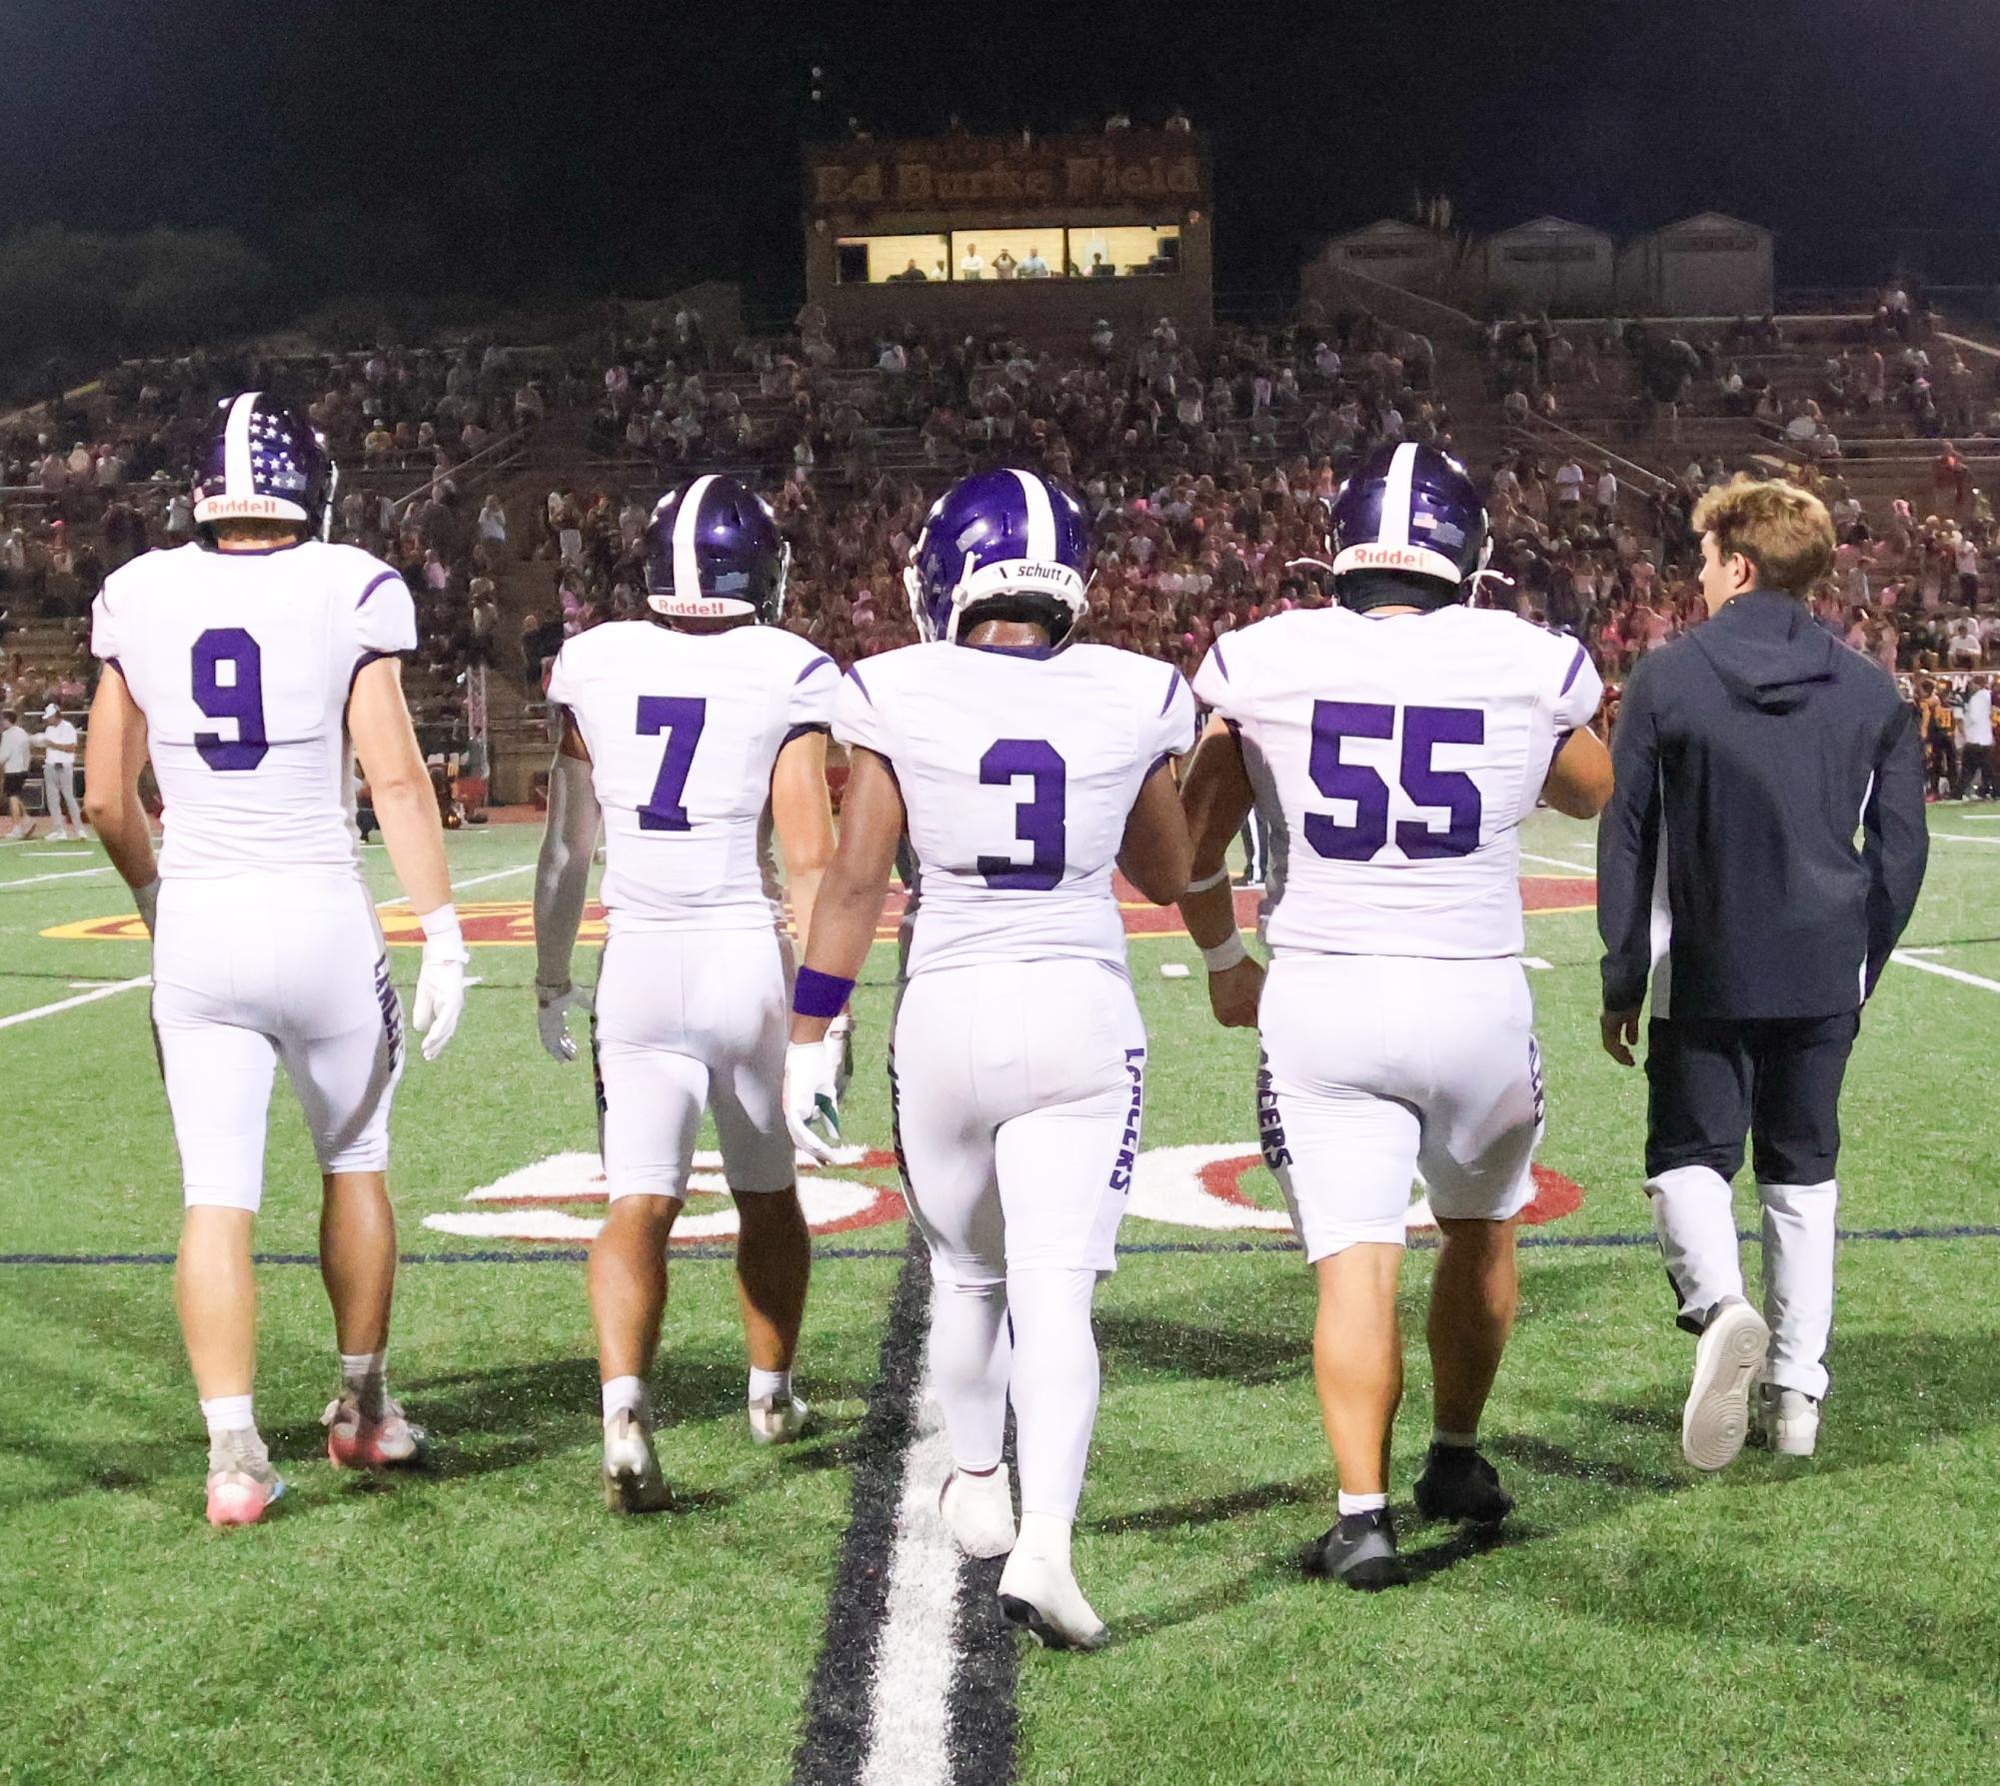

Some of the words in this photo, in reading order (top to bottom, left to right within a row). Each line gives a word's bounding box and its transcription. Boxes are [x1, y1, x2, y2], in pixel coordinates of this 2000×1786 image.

[1066, 156, 1201, 195] Field
[207, 499, 277, 514] Riddell
[1017, 563, 1062, 581] schutt
[1354, 548, 1430, 567] Riddel
[658, 599, 724, 615] Riddell
[192, 628, 270, 771] 9
[637, 696, 706, 831] 7
[1304, 701, 1485, 861] 55
[978, 739, 1065, 890] 3
[1256, 1027, 1294, 1169] NCERS
